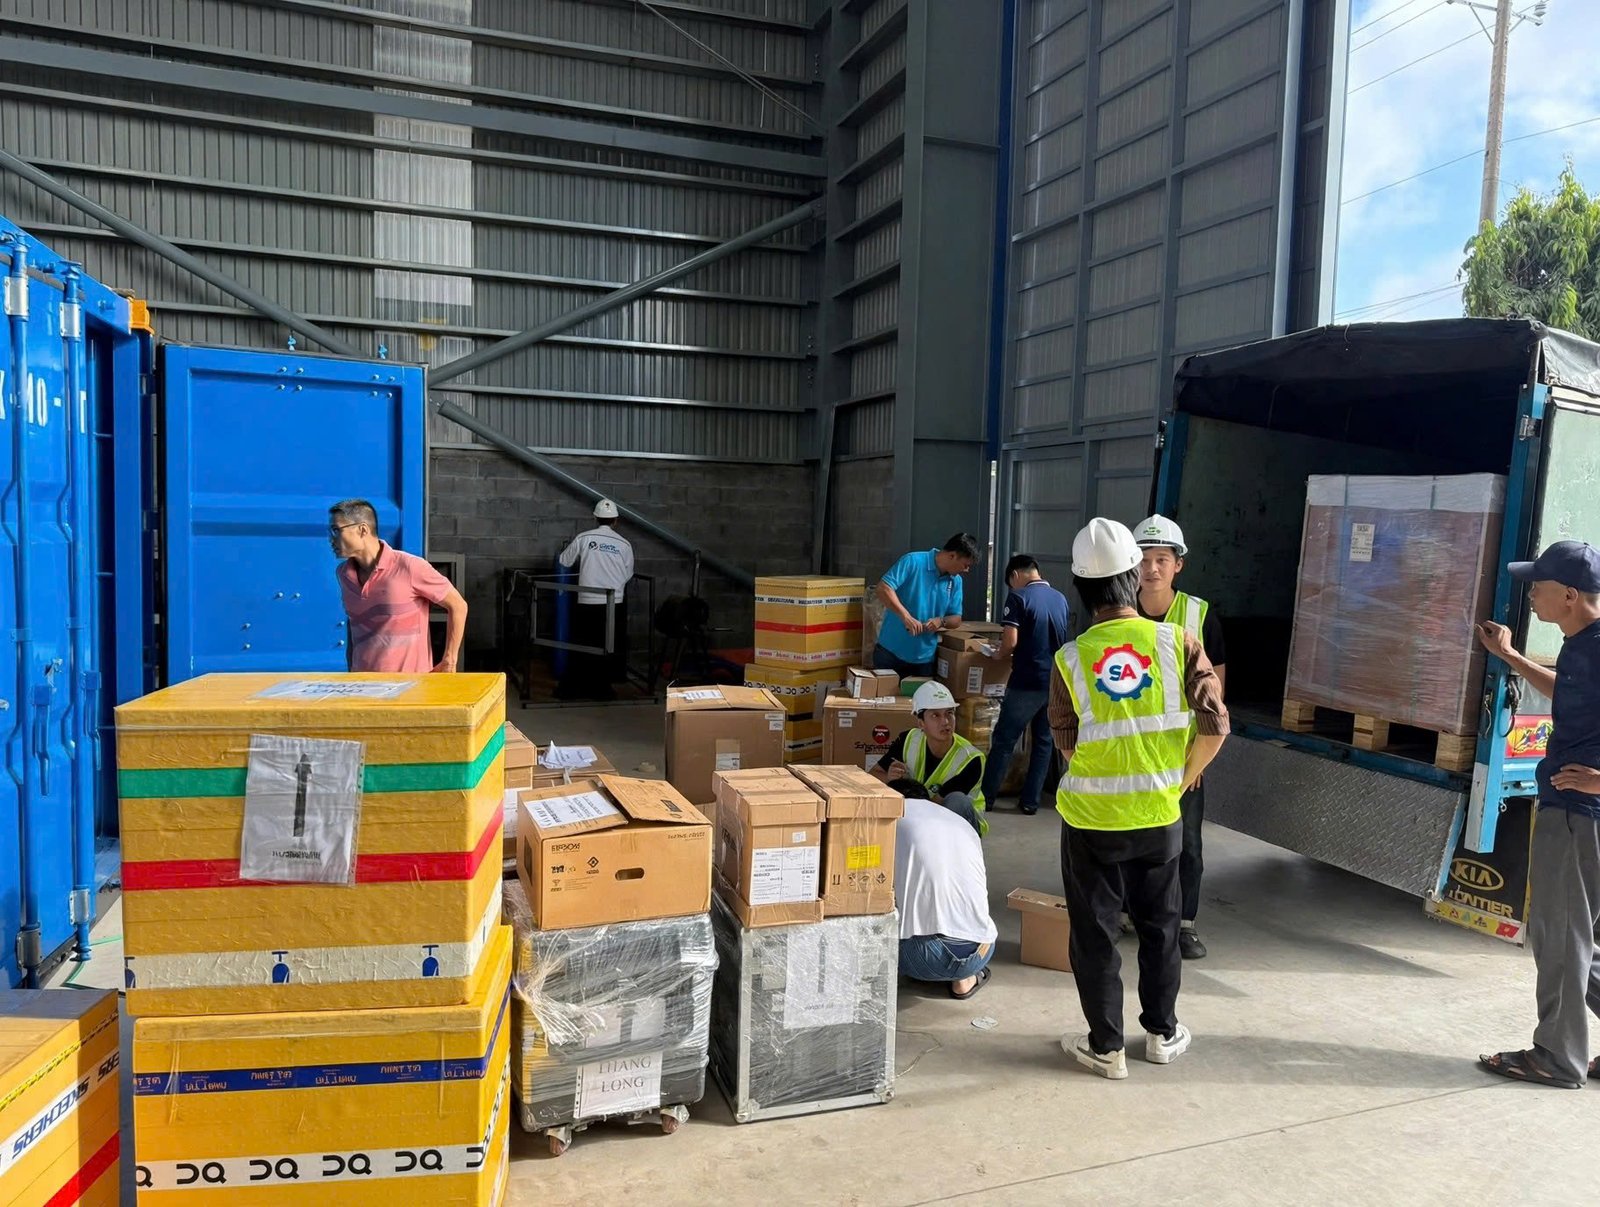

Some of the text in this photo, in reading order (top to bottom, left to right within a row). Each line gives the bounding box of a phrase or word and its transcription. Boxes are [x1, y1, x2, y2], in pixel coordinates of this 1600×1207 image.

[1108, 663, 1137, 681] SA
[1454, 861, 1493, 887] KIA
[601, 1076, 645, 1092] LONG
